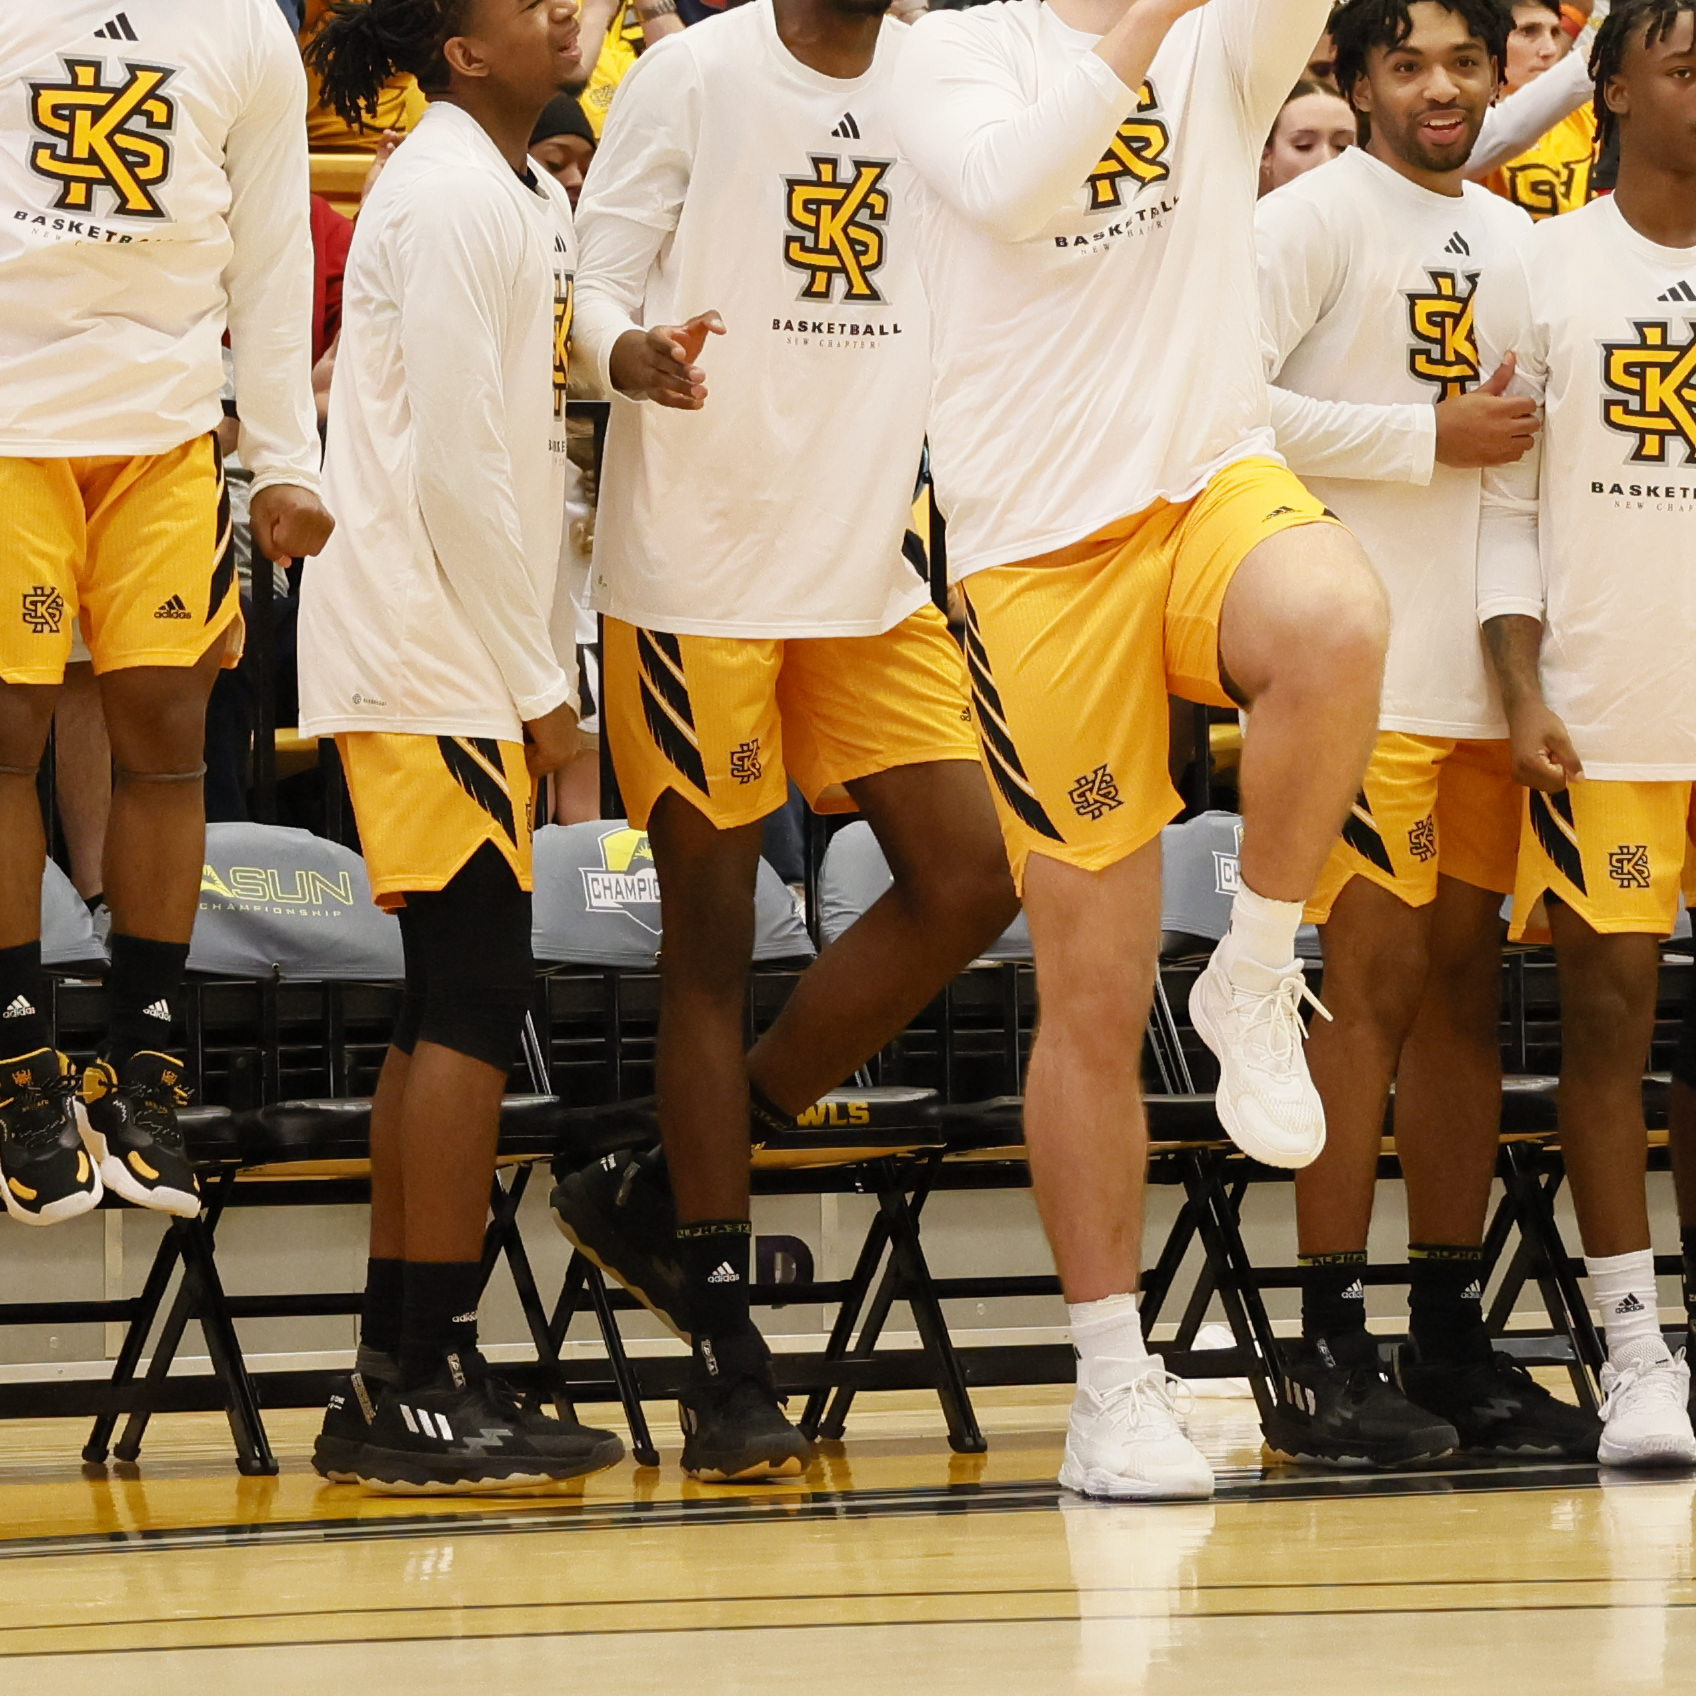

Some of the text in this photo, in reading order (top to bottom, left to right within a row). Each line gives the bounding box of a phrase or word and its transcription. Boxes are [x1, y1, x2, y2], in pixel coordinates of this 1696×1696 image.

[13, 210, 175, 245] BASKETB
[1054, 195, 1180, 249] BASKETALL
[772, 318, 903, 336] BASKETBALL
[1613, 499, 1644, 510] NEW
[153, 610, 191, 620] adidas
[200, 864, 354, 907] ASUN
[199, 901, 344, 919] CHAMPIONSHIP
[2, 1006, 36, 1019] adidas
[796, 1101, 872, 1127] WLS
[707, 1271, 740, 1284] adidas
